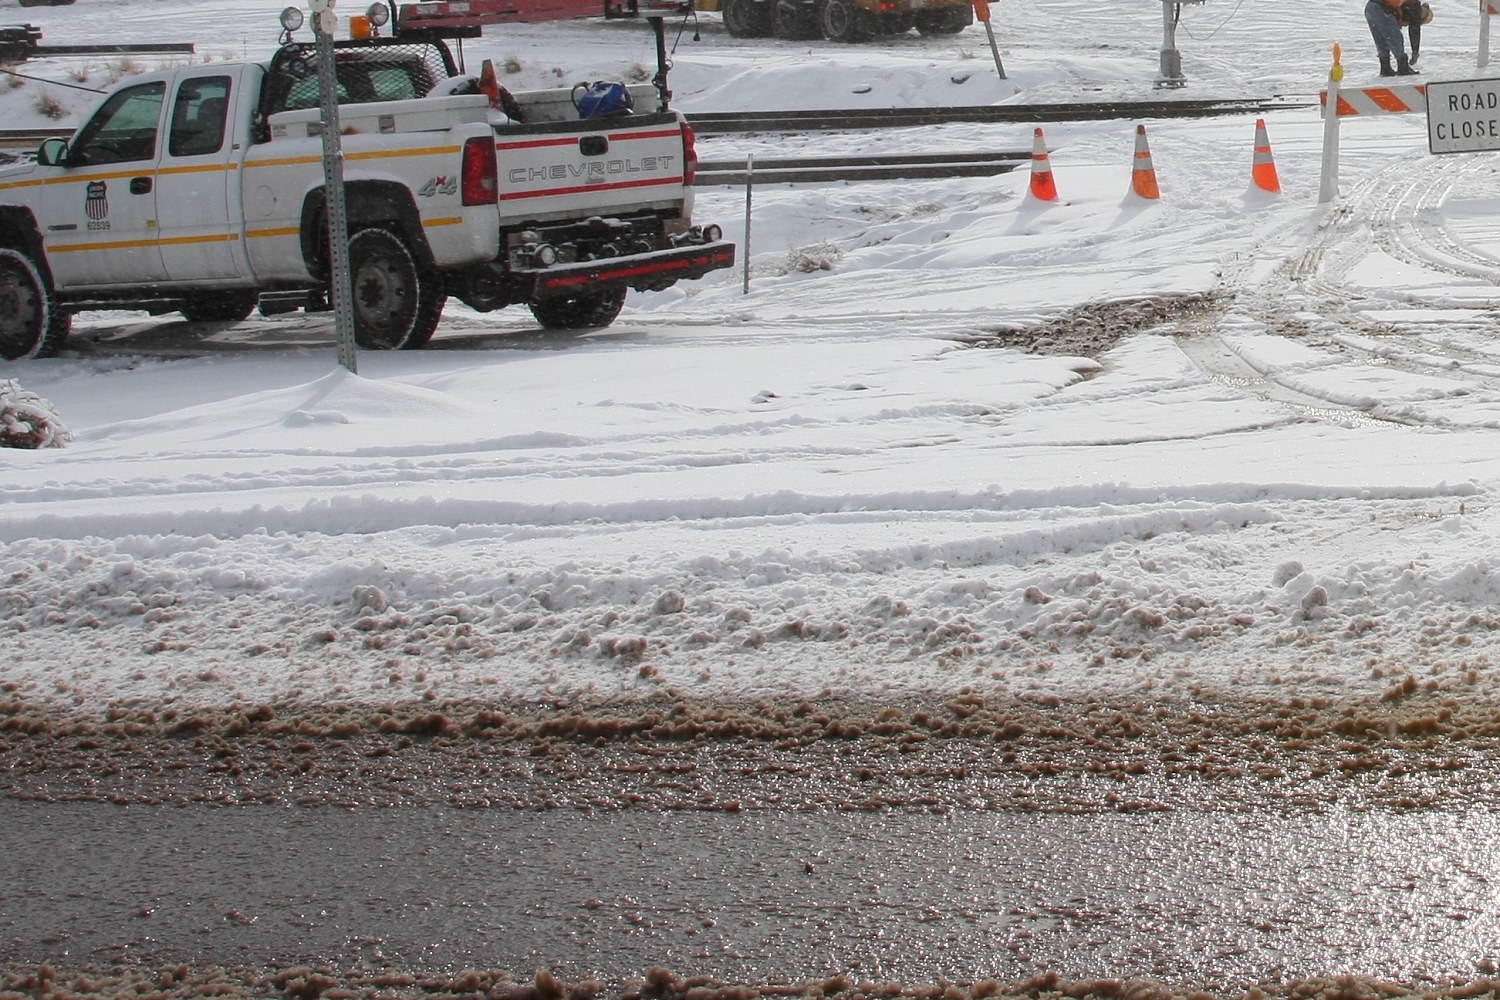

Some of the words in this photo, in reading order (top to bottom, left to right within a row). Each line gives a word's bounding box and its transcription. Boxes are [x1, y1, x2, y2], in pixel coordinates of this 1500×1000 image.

[1448, 92, 1498, 111] ROAD
[508, 155, 675, 184] CHEVROLET
[87, 221, 111, 231] 62839
